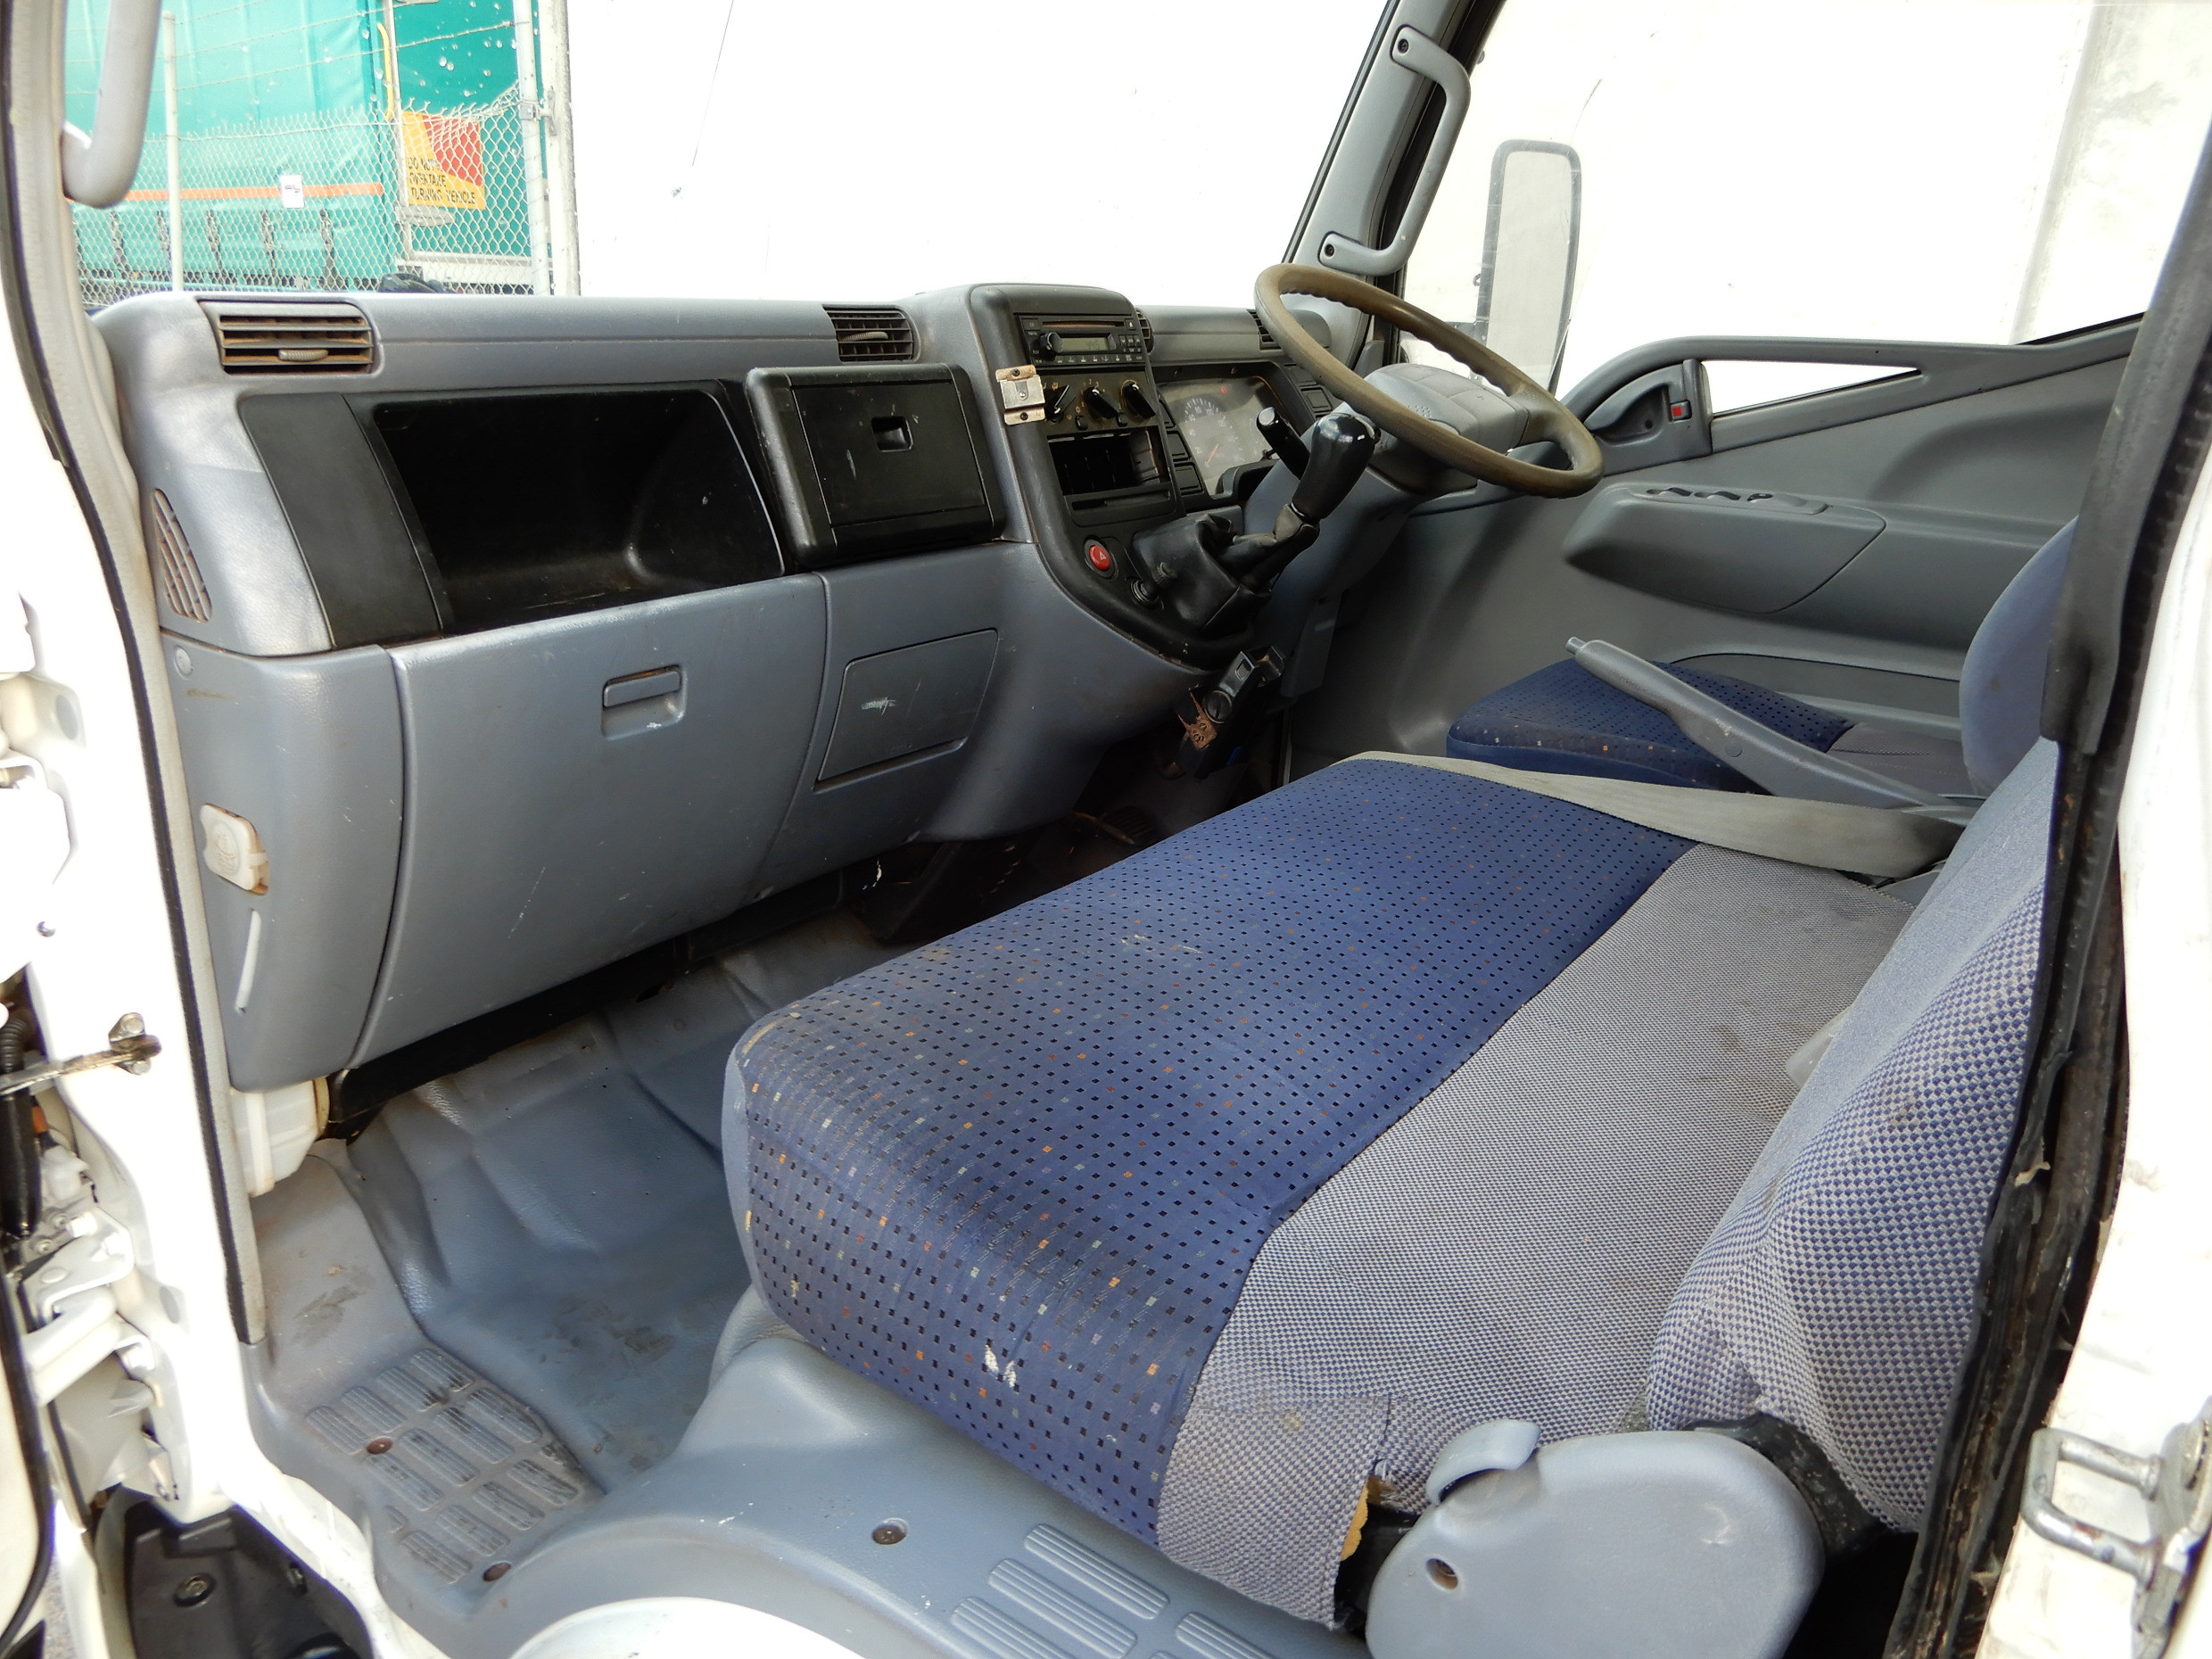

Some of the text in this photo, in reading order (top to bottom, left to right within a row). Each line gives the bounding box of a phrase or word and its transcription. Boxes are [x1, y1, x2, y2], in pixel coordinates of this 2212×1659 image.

[408, 157, 419, 169] DO
[409, 172, 447, 187] OVERTAKE
[410, 187, 476, 204] TURNING VEHICLE
